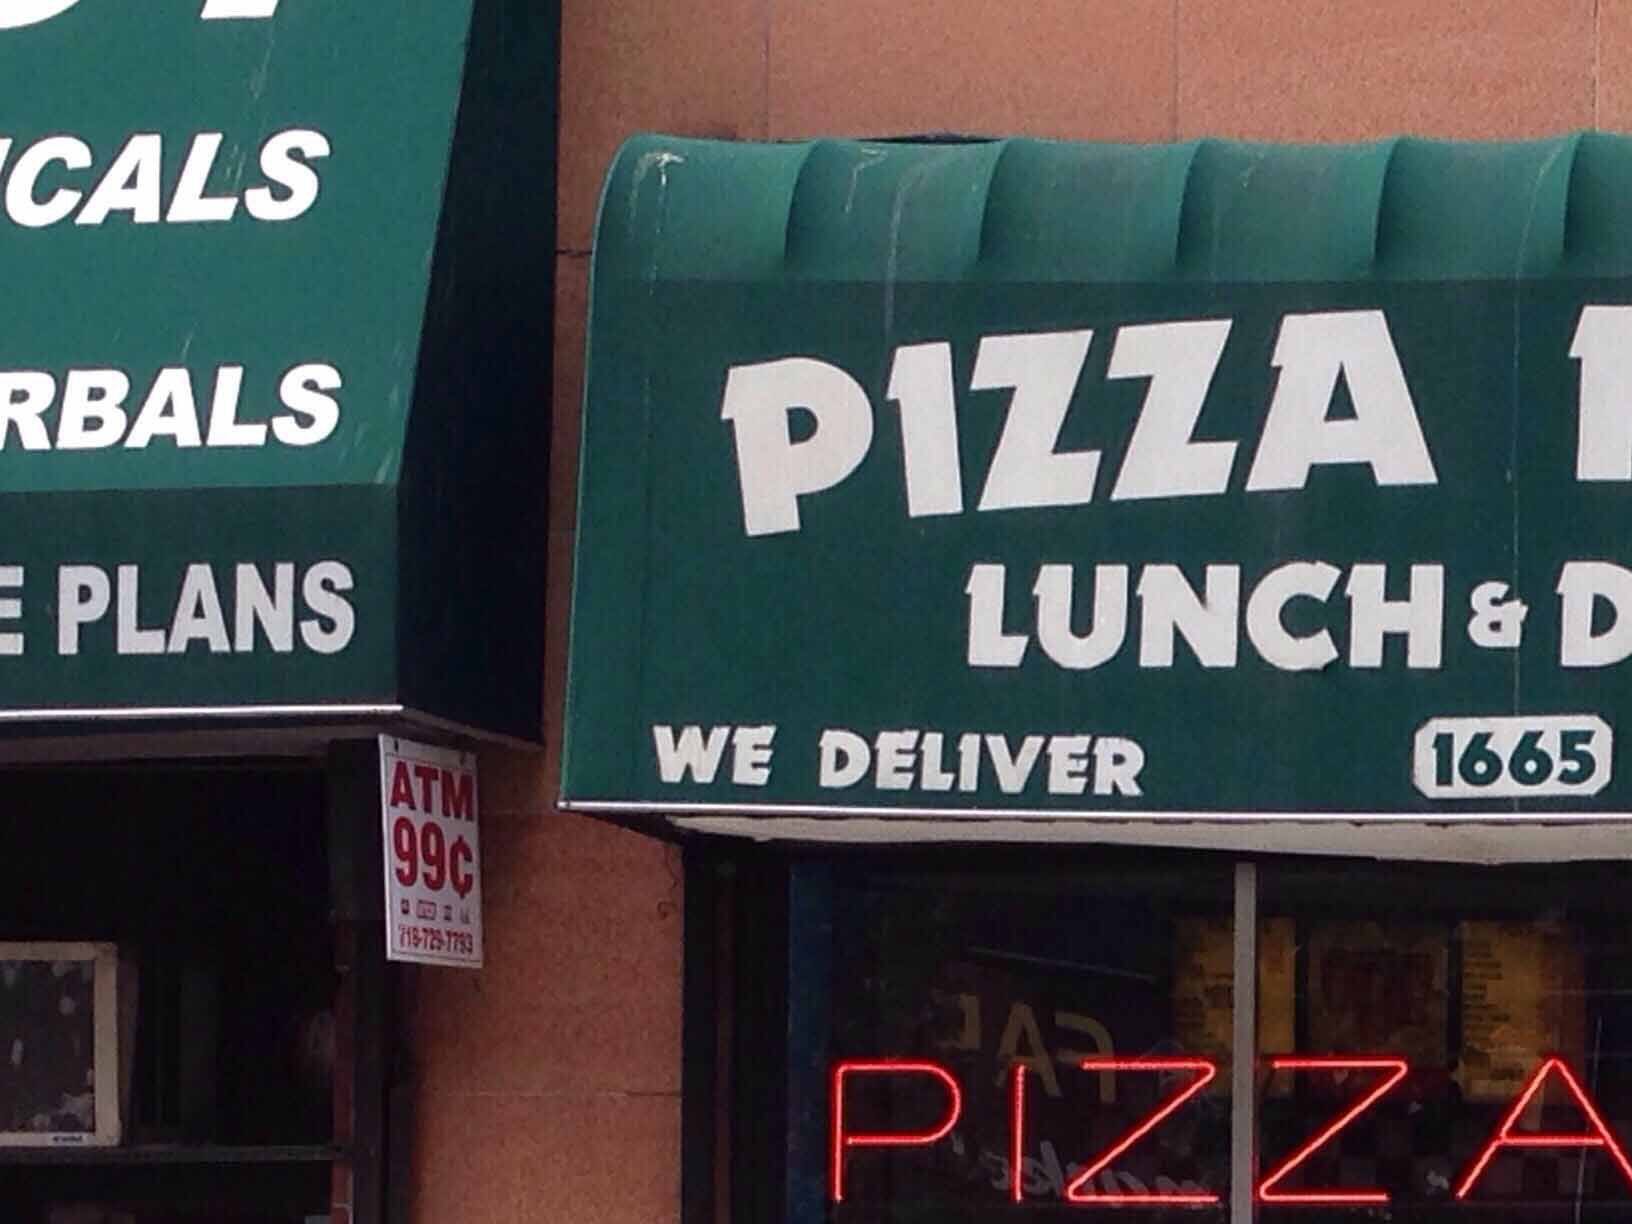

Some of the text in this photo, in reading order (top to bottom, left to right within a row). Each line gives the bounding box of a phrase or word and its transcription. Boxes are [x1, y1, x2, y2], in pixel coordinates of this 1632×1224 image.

[720, 308, 1439, 538] PIZZA
[57, 560, 356, 656] PLANS
[966, 560, 1444, 672] LUNCH
[1468, 581, 1527, 649] &
[390, 761, 474, 822] ATM
[652, 724, 1145, 796] WE DELIVER
[1431, 730, 1597, 788] 1665
[393, 816, 474, 899] 99¢
